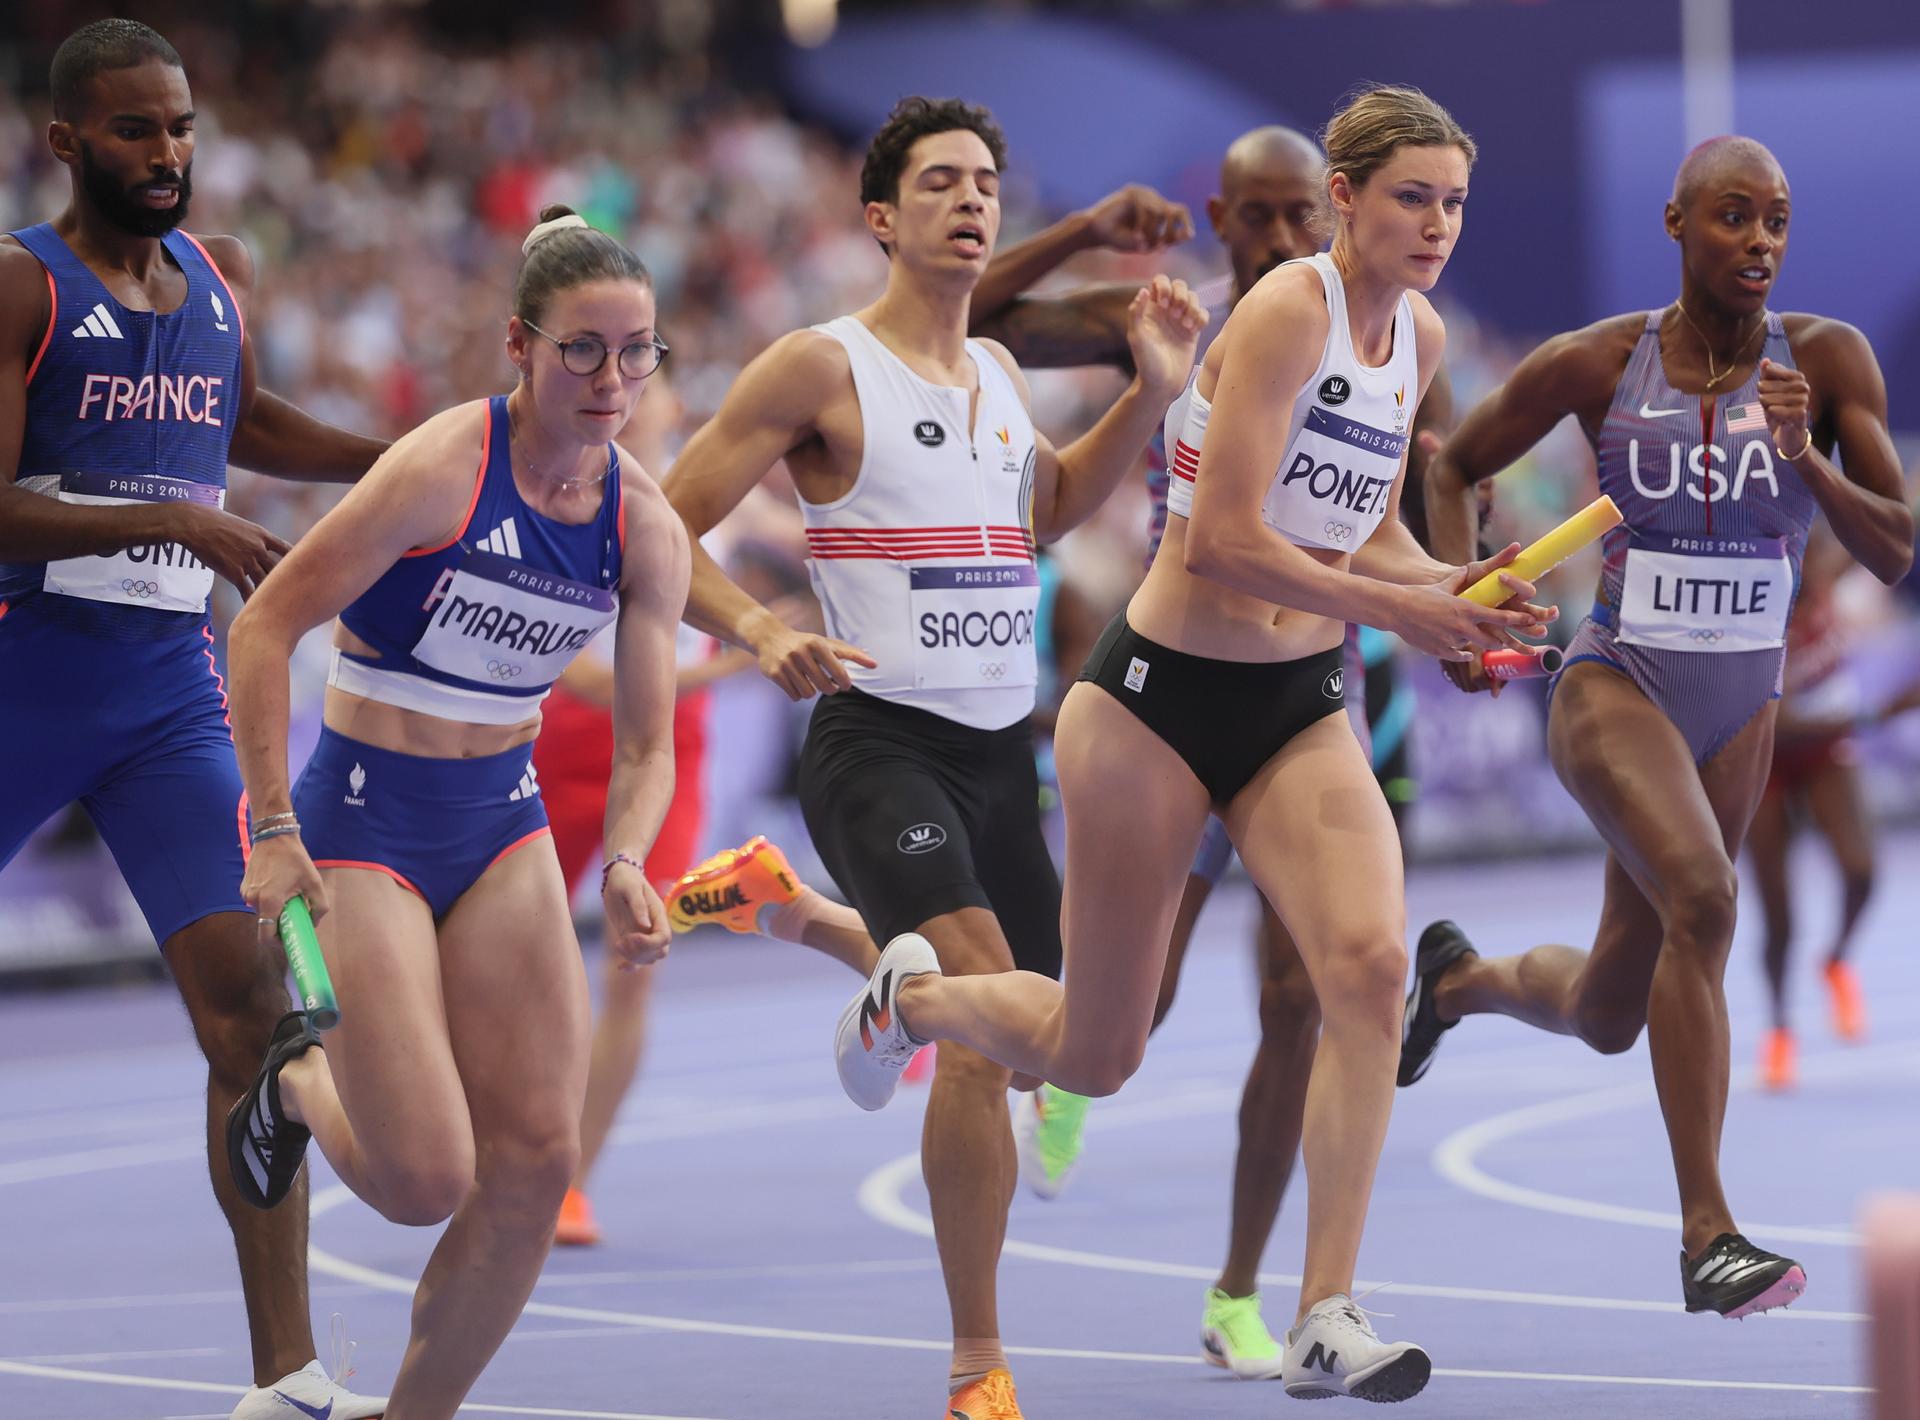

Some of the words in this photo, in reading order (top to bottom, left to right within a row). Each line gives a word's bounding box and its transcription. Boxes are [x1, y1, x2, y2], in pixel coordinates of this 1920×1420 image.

[78, 373, 224, 428] FRANCE
[1344, 425, 1381, 447] PARIS
[1382, 438, 1406, 454] 202
[1627, 438, 1780, 503] USA
[109, 479, 154, 496] PARIS
[159, 486, 189, 500] 2024
[1672, 537, 1714, 552] PARIS
[1719, 539, 1757, 554] 2024
[507, 569, 551, 592] PARIS
[554, 584, 594, 603] 2024
[955, 571, 993, 583] PARIS
[1653, 575, 1771, 616] LITTLE
[343, 794, 366, 808] FRANCE
[682, 882, 751, 916] NITRO
[1300, 1340, 1339, 1374] N
